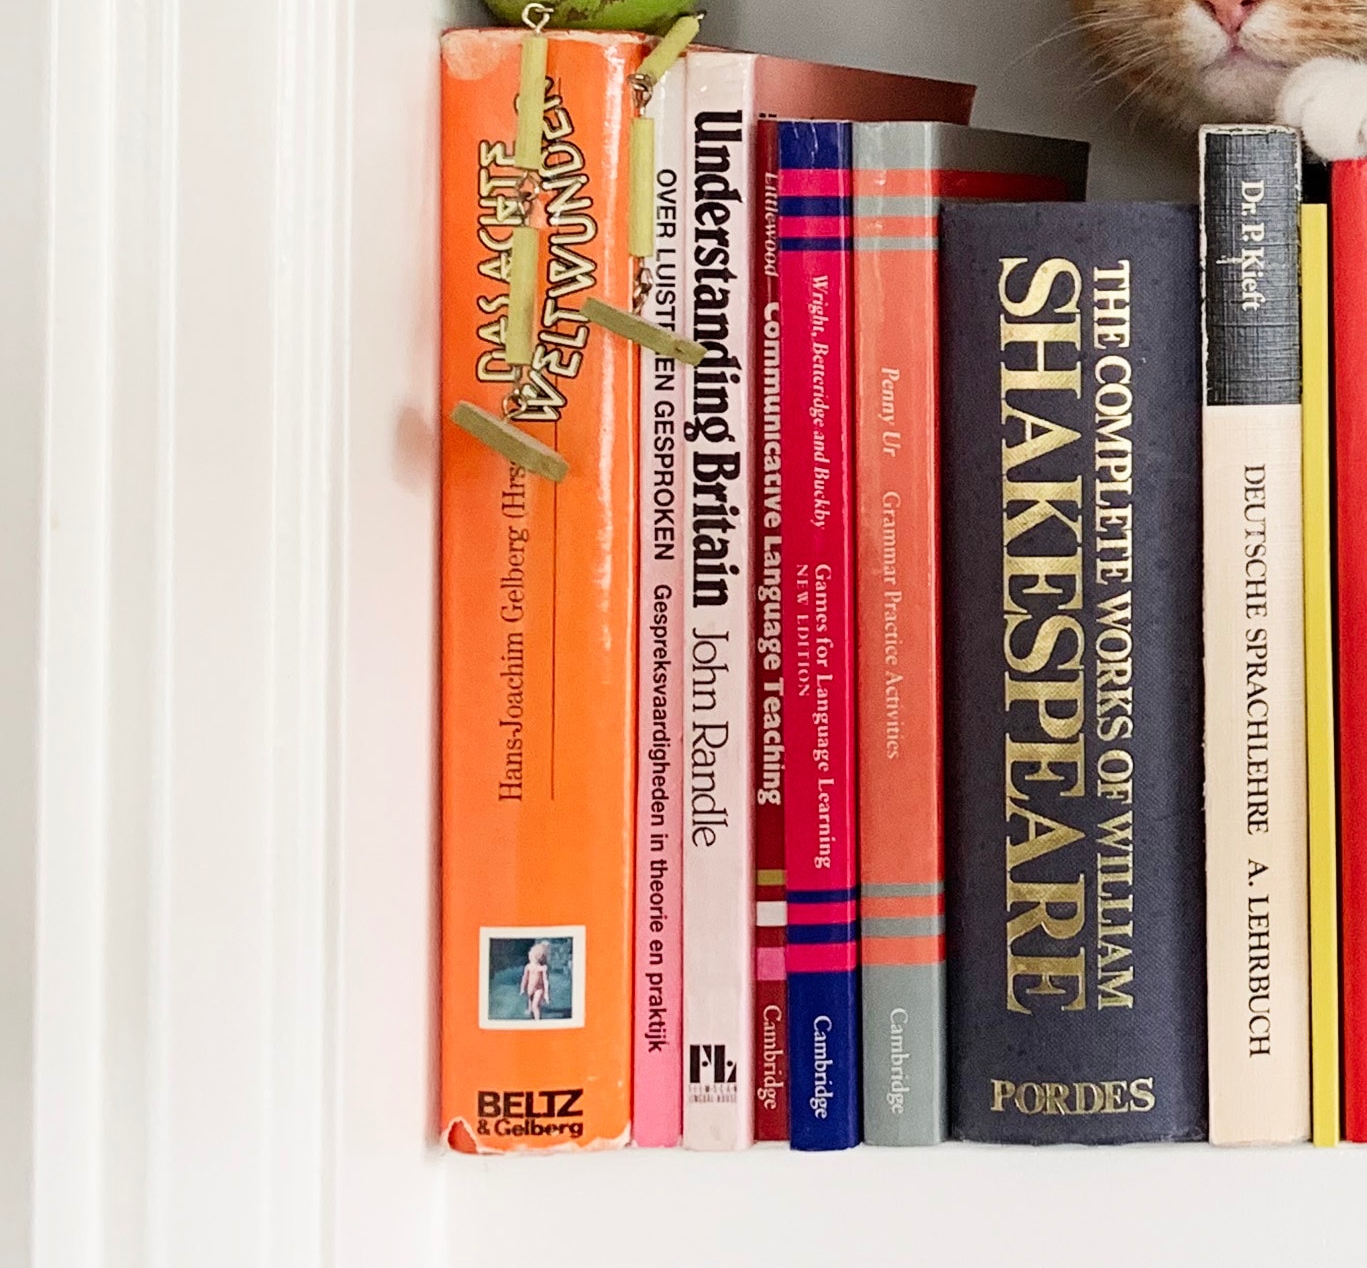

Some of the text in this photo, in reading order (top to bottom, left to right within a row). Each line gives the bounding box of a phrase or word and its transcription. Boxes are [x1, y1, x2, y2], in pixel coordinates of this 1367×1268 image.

[880, 366, 902, 458] Penny Ur
[1244, 464, 1268, 620] DEUTSCHE
[692, 450, 741, 848] Britain John Randle
[998, 257, 1086, 1015] SHAKESPEARE
[1093, 259, 1134, 1010] THE COMPLETE WORKS OF WILLIAM
[1245, 626, 1269, 835] SPRACHLEHRE
[644, 584, 673, 1053] Gespreksvaardigheden in theorie en praktijk
[1247, 894, 1270, 1058] LEHRBUCH
[477, 1089, 583, 1119] BELTZ
[477, 1119, 584, 1138] & Gelberg
[889, 1008, 909, 1115] Cambridge
[990, 1077, 1156, 1116] PORDES
